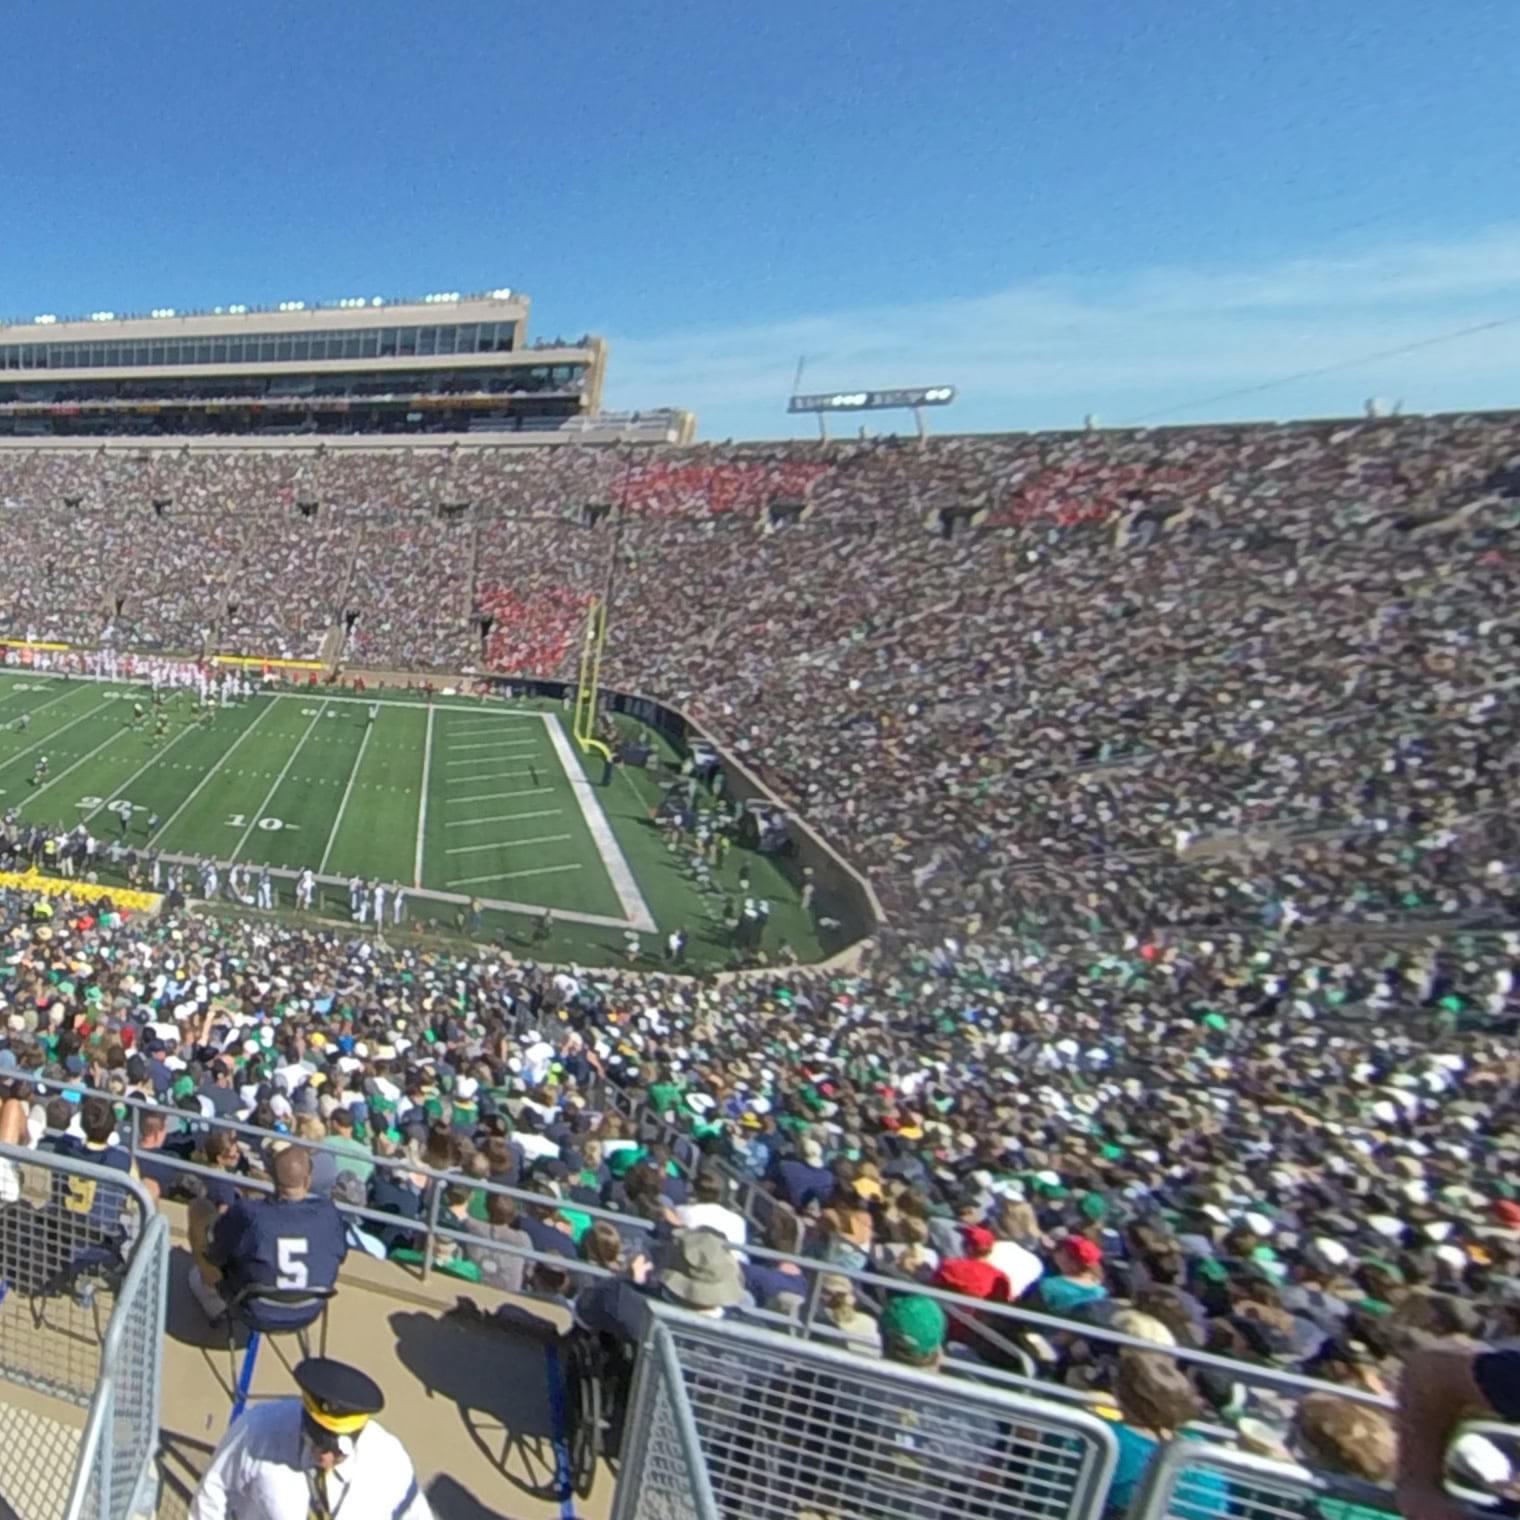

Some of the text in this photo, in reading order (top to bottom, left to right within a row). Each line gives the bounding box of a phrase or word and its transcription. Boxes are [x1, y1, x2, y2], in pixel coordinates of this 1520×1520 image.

[74, 796, 133, 812] 20
[223, 813, 284, 831] 10
[276, 1237, 309, 1289] 5
